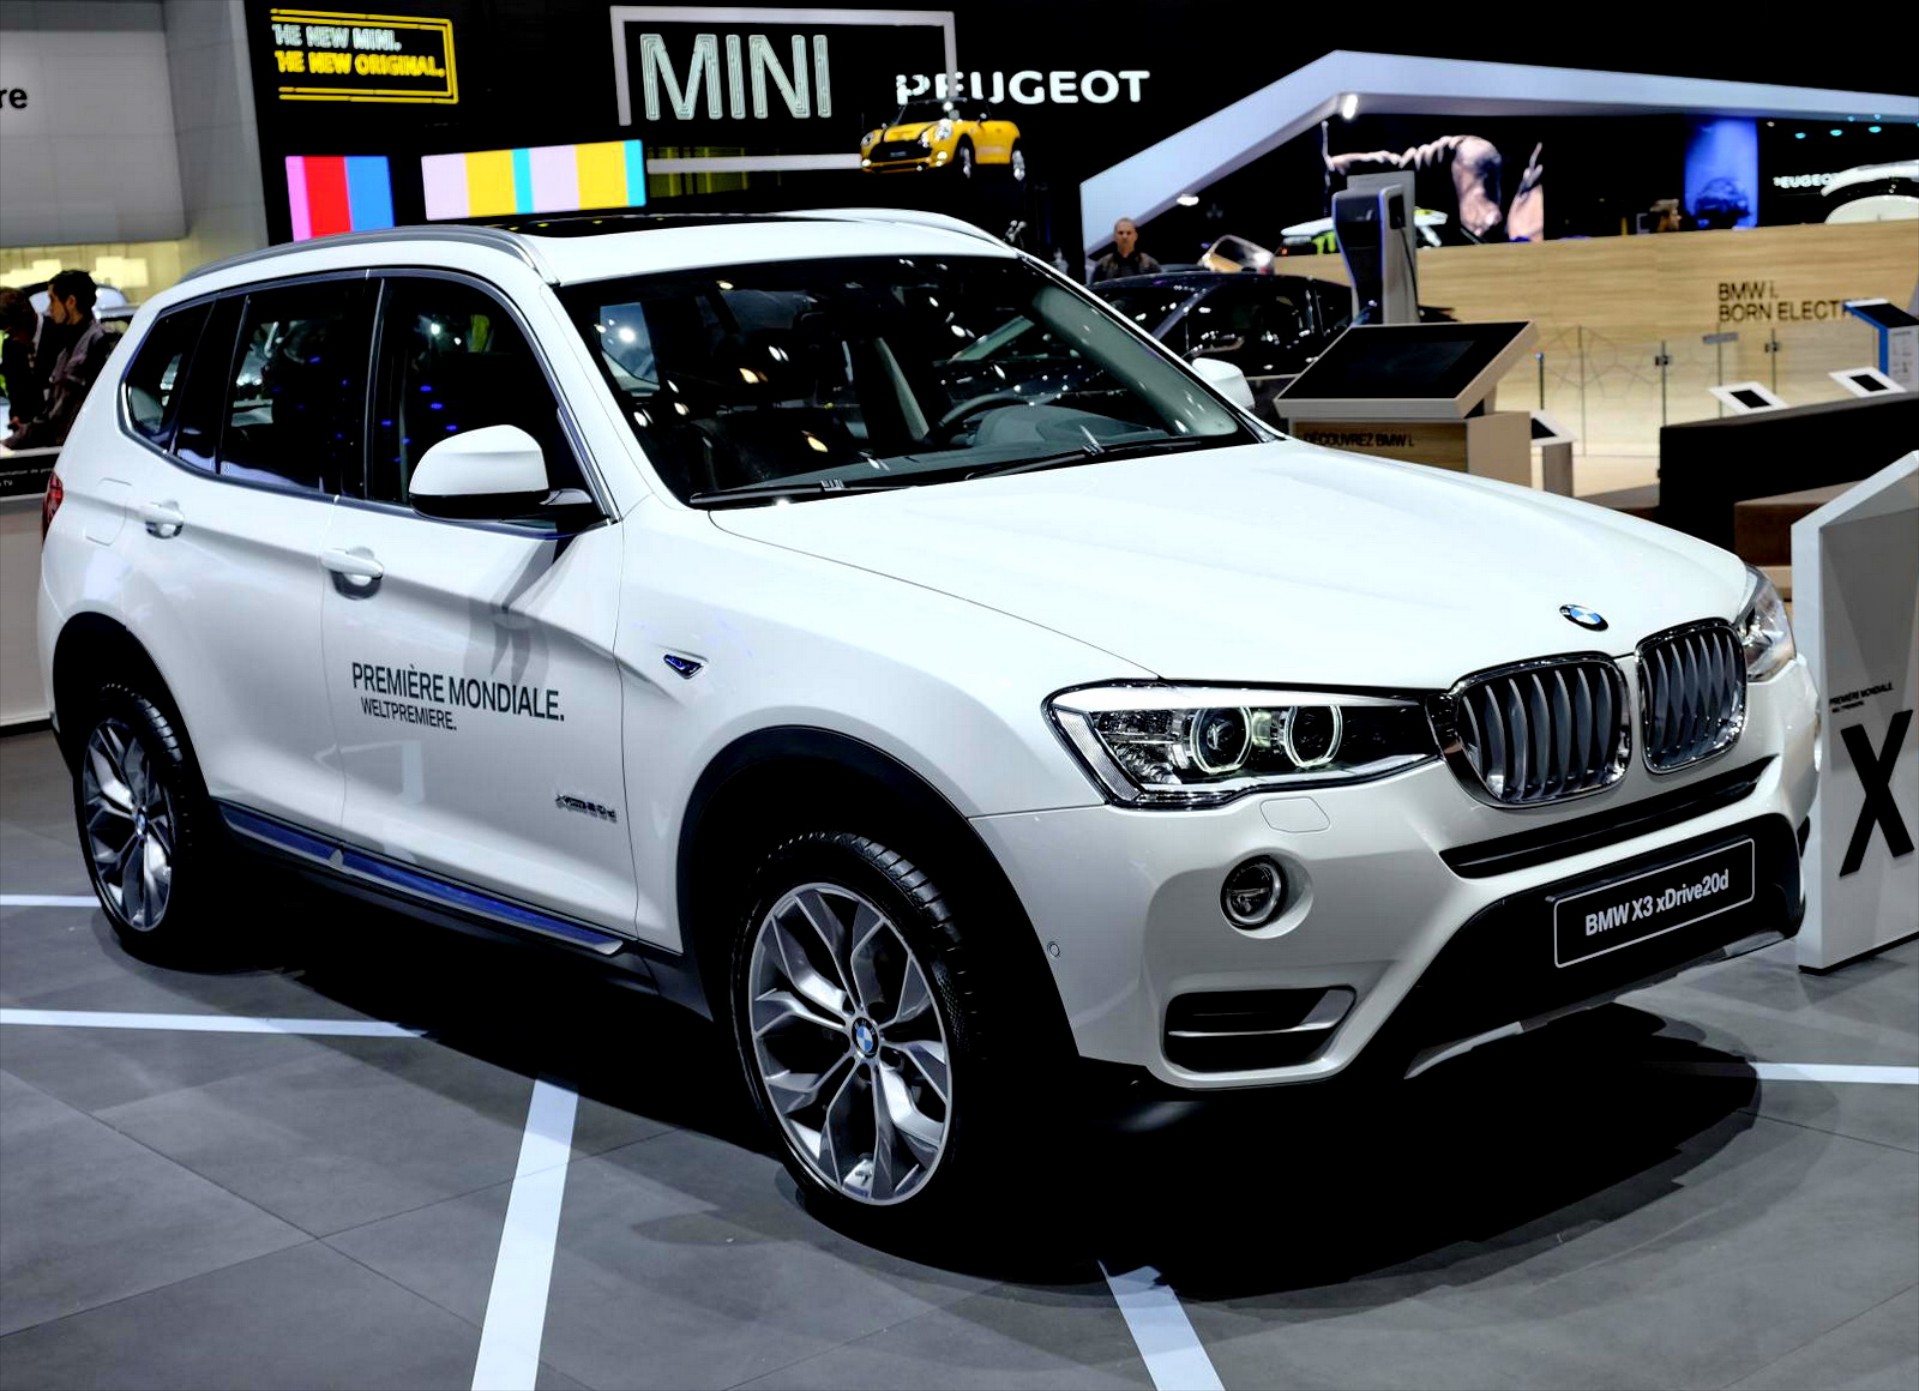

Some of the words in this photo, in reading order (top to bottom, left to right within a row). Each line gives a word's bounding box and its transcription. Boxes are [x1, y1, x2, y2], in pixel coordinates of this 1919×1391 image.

[306, 26, 350, 49] NEW
[308, 52, 352, 74] NEW
[640, 34, 832, 120] MINI
[896, 70, 1150, 105] PEUGEOT
[1718, 282, 1765, 301] BMW
[1719, 302, 1771, 322] BORN
[352, 662, 445, 703] PREMIÈRE
[449, 676, 565, 721] MONDIALE.
[361, 697, 457, 730] WELTPREMIERE.
[1839, 709, 1915, 877] X
[1585, 902, 1630, 936] BMW
[1631, 896, 1654, 921] X3
[1655, 868, 1729, 913] xDrive20d
